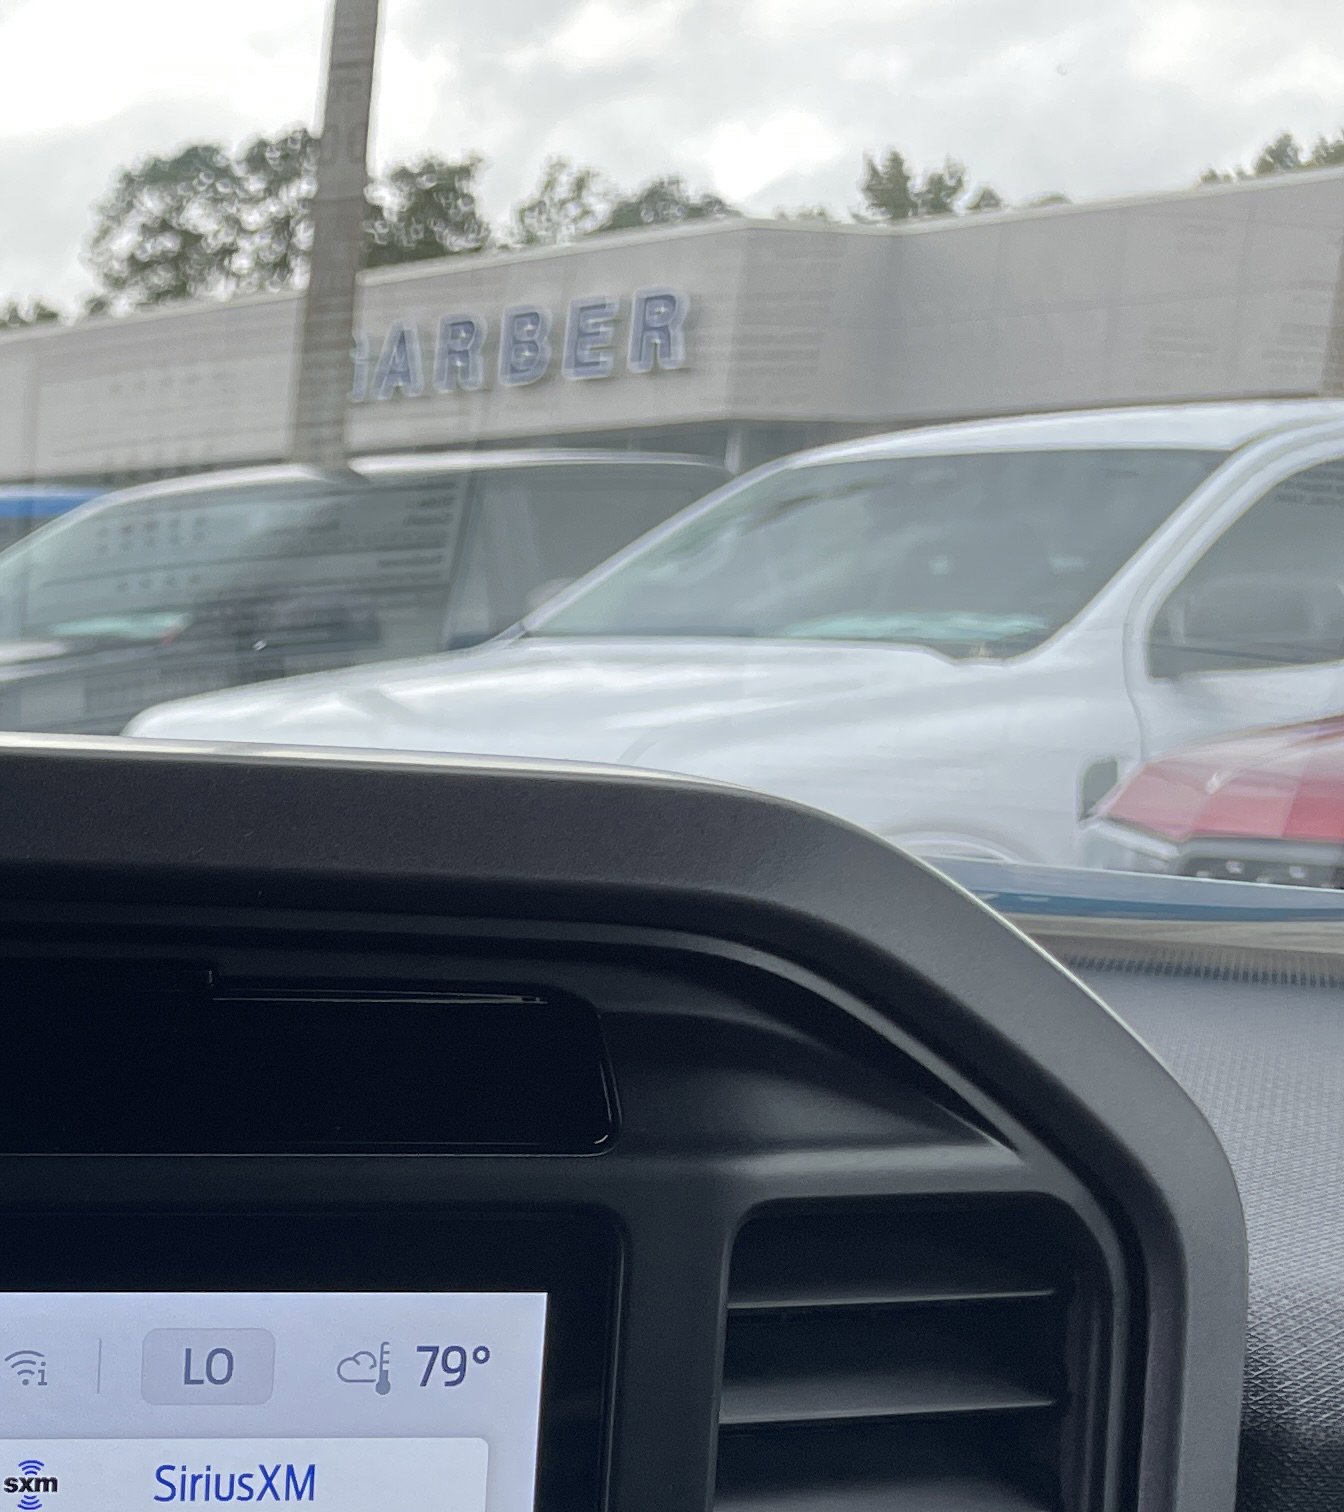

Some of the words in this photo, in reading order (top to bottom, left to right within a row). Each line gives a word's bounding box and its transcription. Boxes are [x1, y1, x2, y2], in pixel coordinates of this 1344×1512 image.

[183, 1347, 234, 1386] LO
[3, 1475, 58, 1494] sxm
[153, 1463, 316, 1502] SiriusXM
